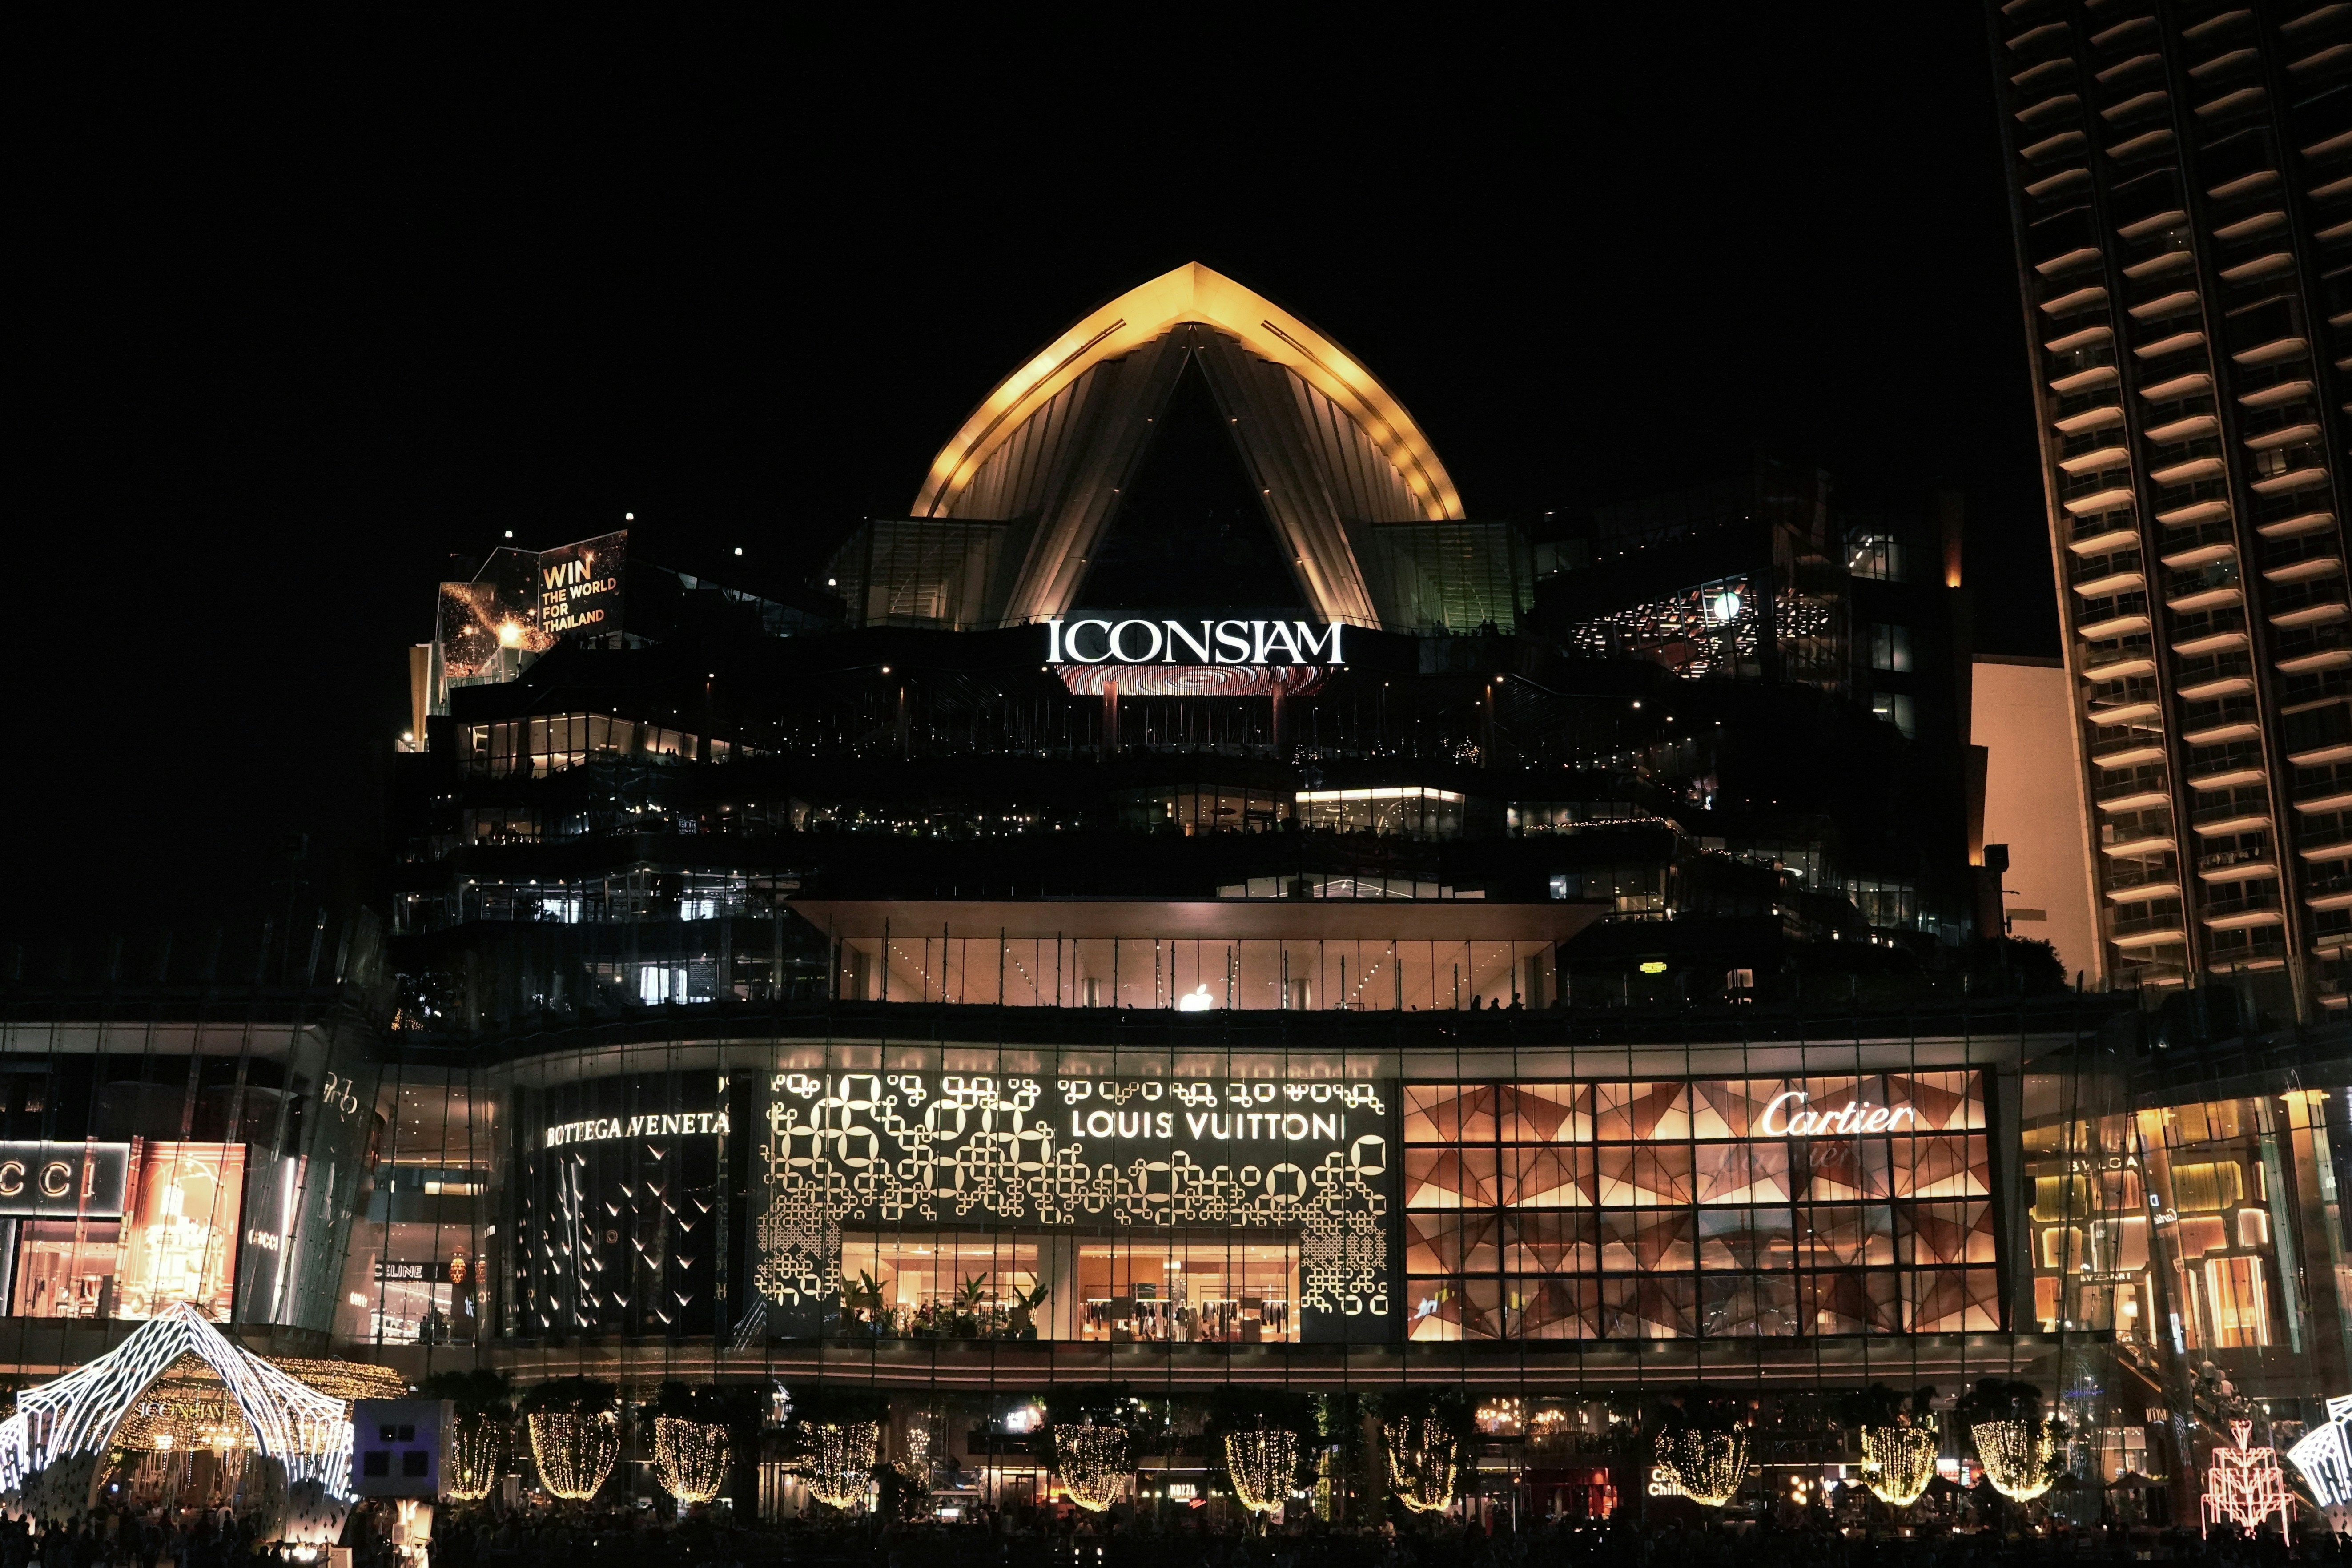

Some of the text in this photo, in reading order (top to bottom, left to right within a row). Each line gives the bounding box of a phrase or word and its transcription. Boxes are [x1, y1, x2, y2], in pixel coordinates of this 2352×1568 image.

[543, 559, 591, 590] WIN
[542, 577, 617, 605] THE WORLD
[543, 603, 568, 619] FOR
[543, 609, 604, 634] THAILAND
[1045, 619, 1345, 664] ICONSIAM
[1072, 1110, 1336, 1141] LOUIS VUITTON
[1761, 1091, 1915, 1136] Cartier
[546, 1112, 731, 1148] BOTTEGA VENETA
[140, 1402, 228, 1420] ICONSIAM
